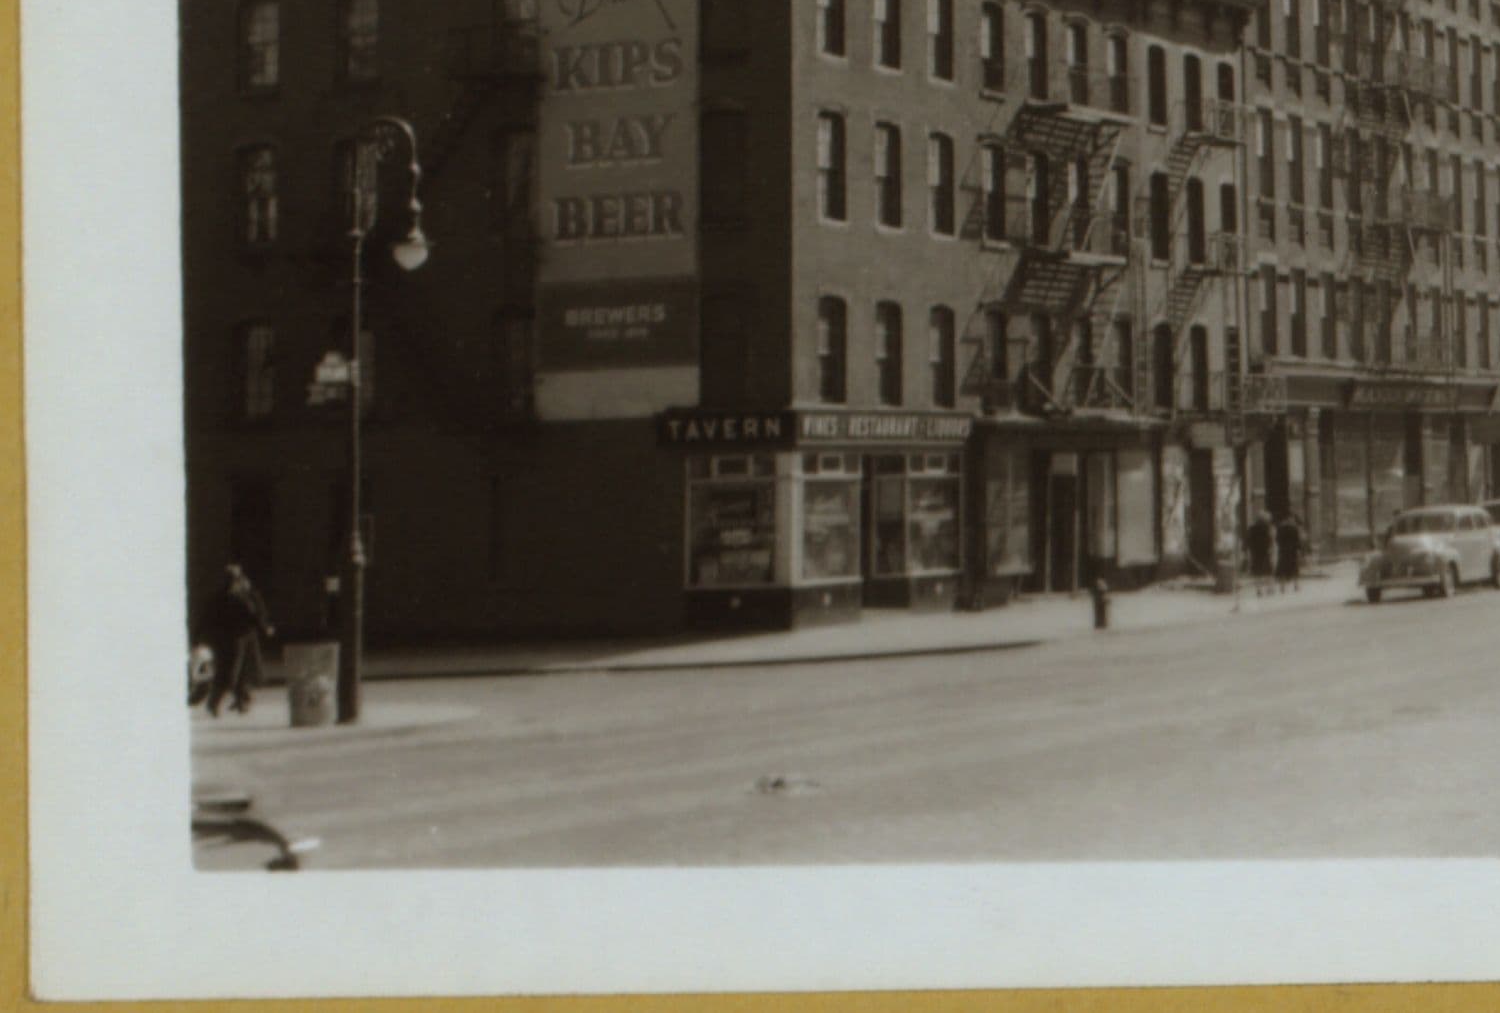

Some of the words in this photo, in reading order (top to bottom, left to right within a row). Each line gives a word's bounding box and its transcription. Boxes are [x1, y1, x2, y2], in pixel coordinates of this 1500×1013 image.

[552, 37, 684, 93] KIPS
[565, 113, 679, 168] BAY
[551, 188, 685, 246] BEER
[565, 303, 667, 328] BREWERS
[668, 416, 782, 442] TAVERN
